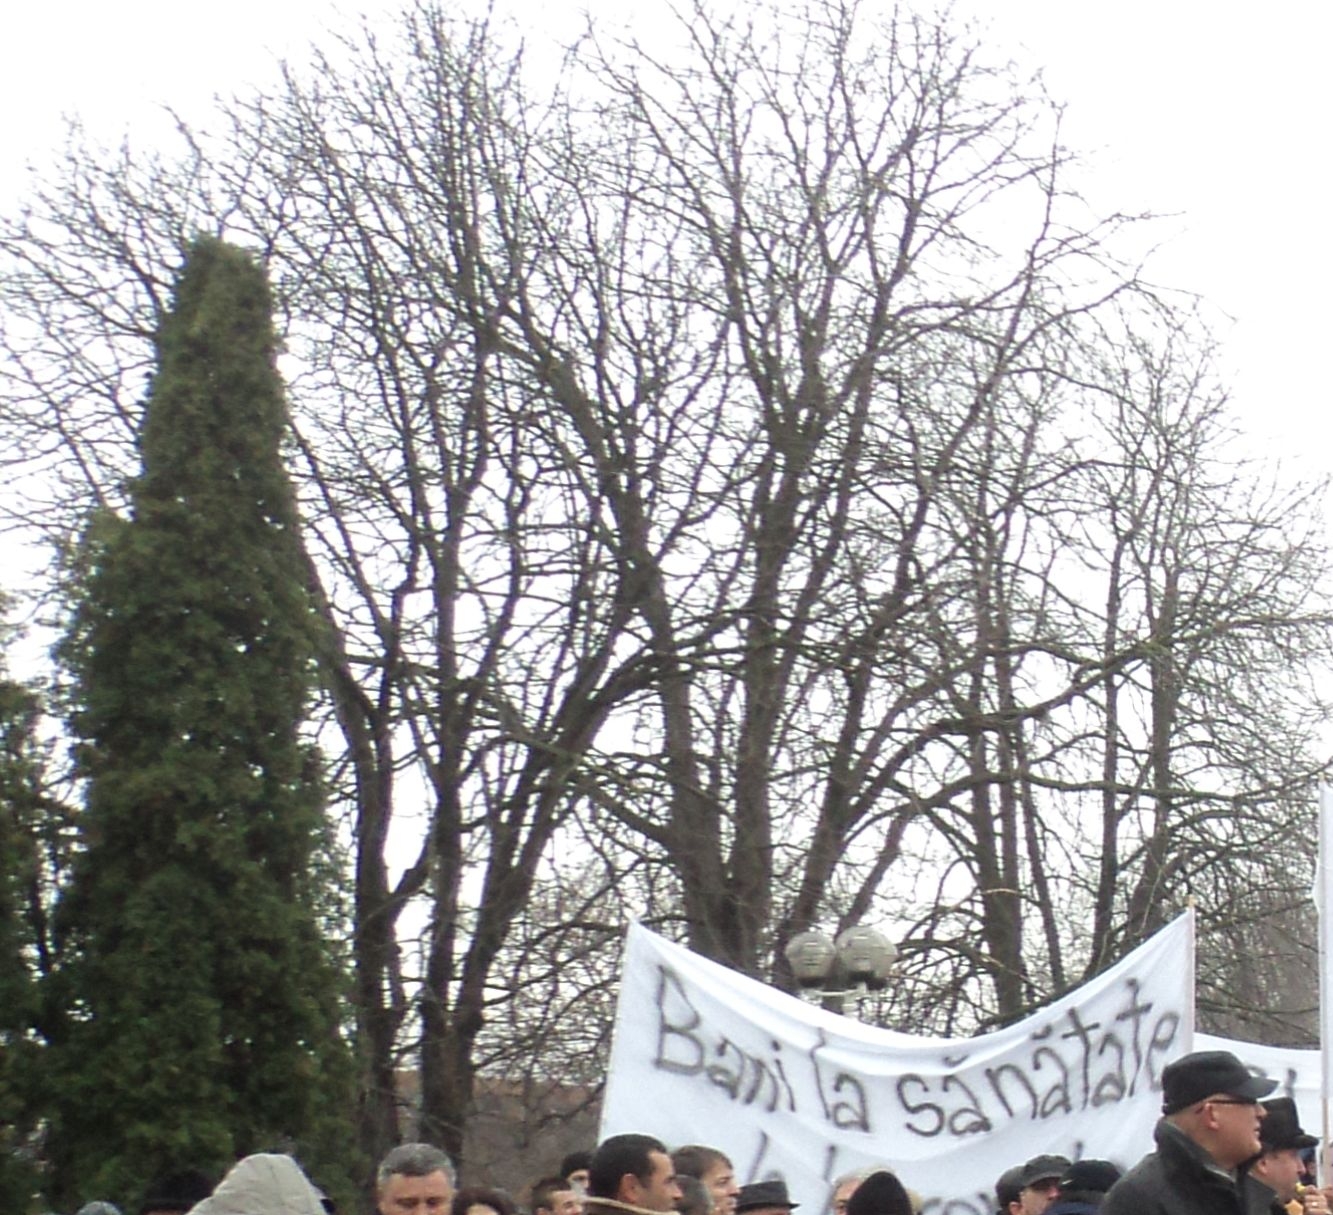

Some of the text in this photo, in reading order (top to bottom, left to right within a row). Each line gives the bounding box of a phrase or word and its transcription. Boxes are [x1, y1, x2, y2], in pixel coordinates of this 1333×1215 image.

[654, 963, 1181, 1138] Bani la sănătate
